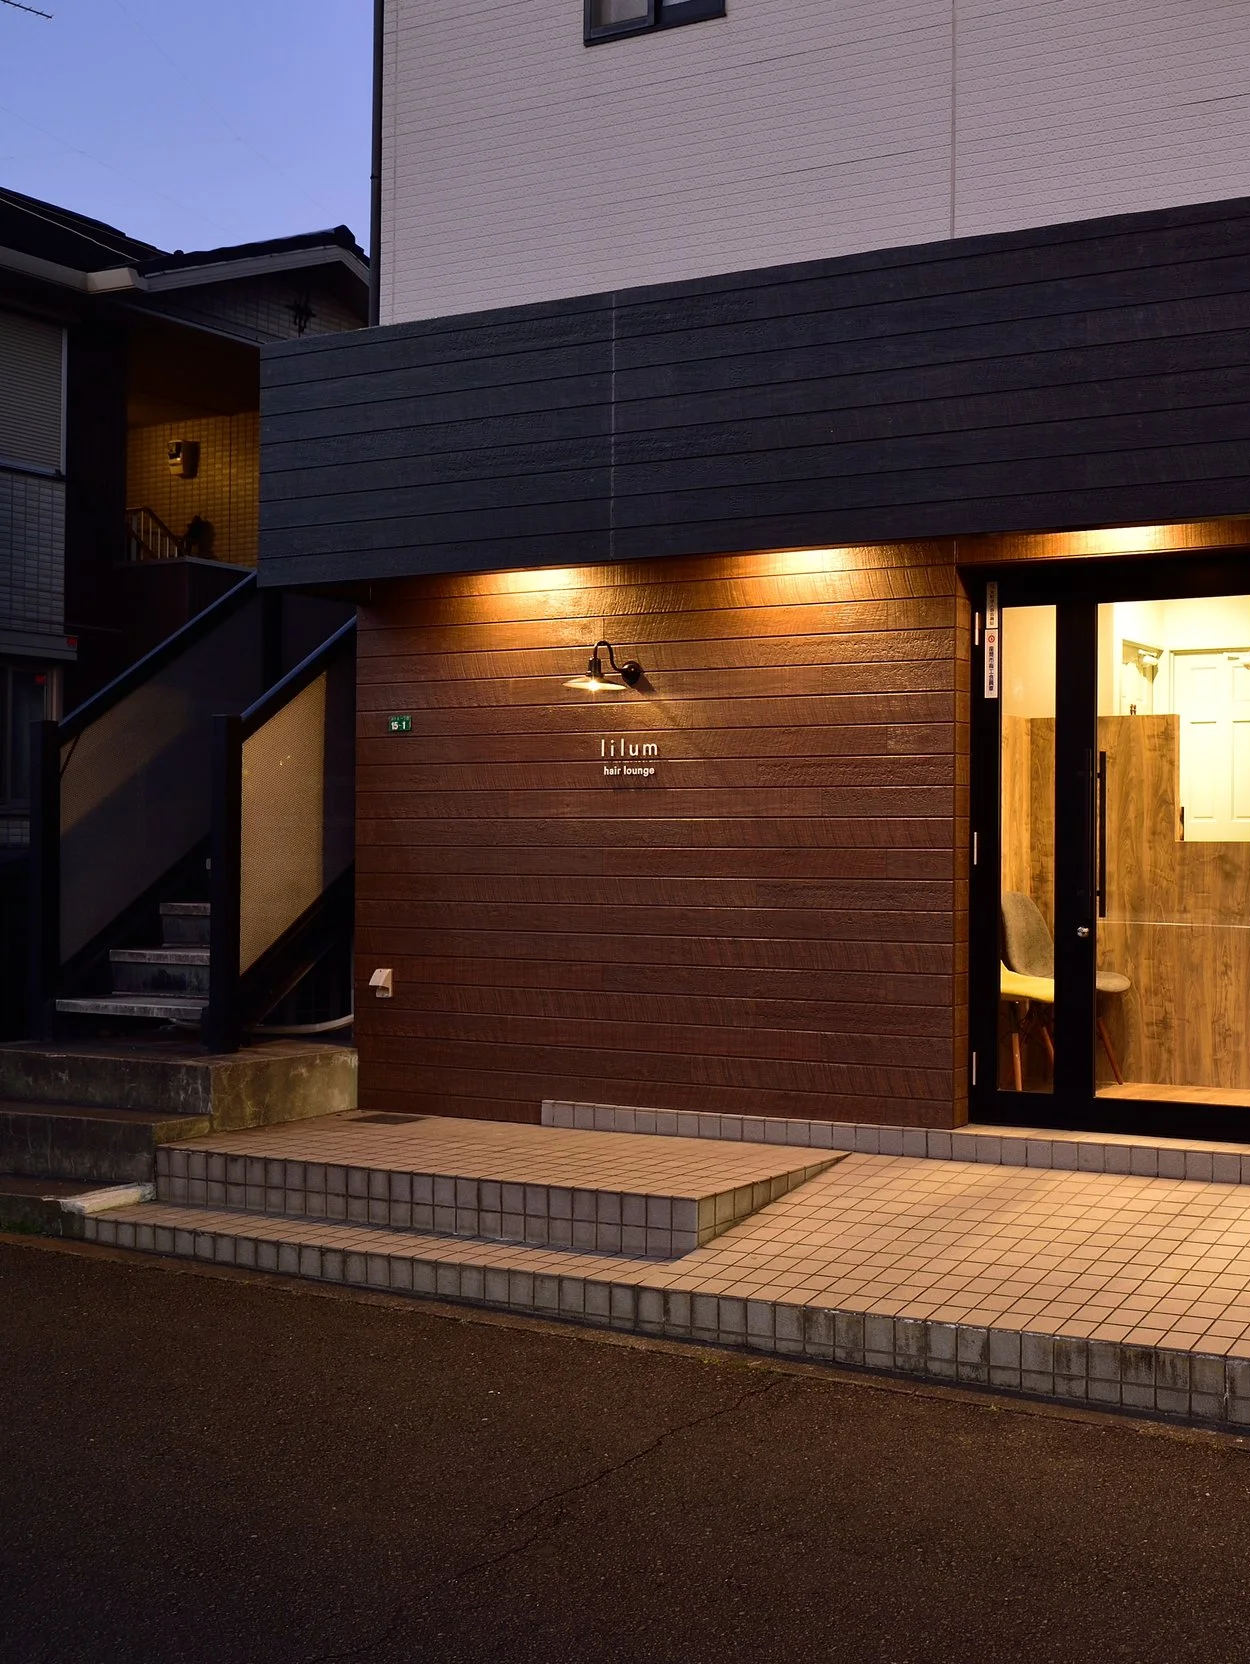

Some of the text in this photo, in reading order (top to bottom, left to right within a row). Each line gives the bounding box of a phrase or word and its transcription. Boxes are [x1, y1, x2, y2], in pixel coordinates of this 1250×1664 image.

[600, 738, 658, 756] lilum
[603, 765, 655, 777] hair lounge
